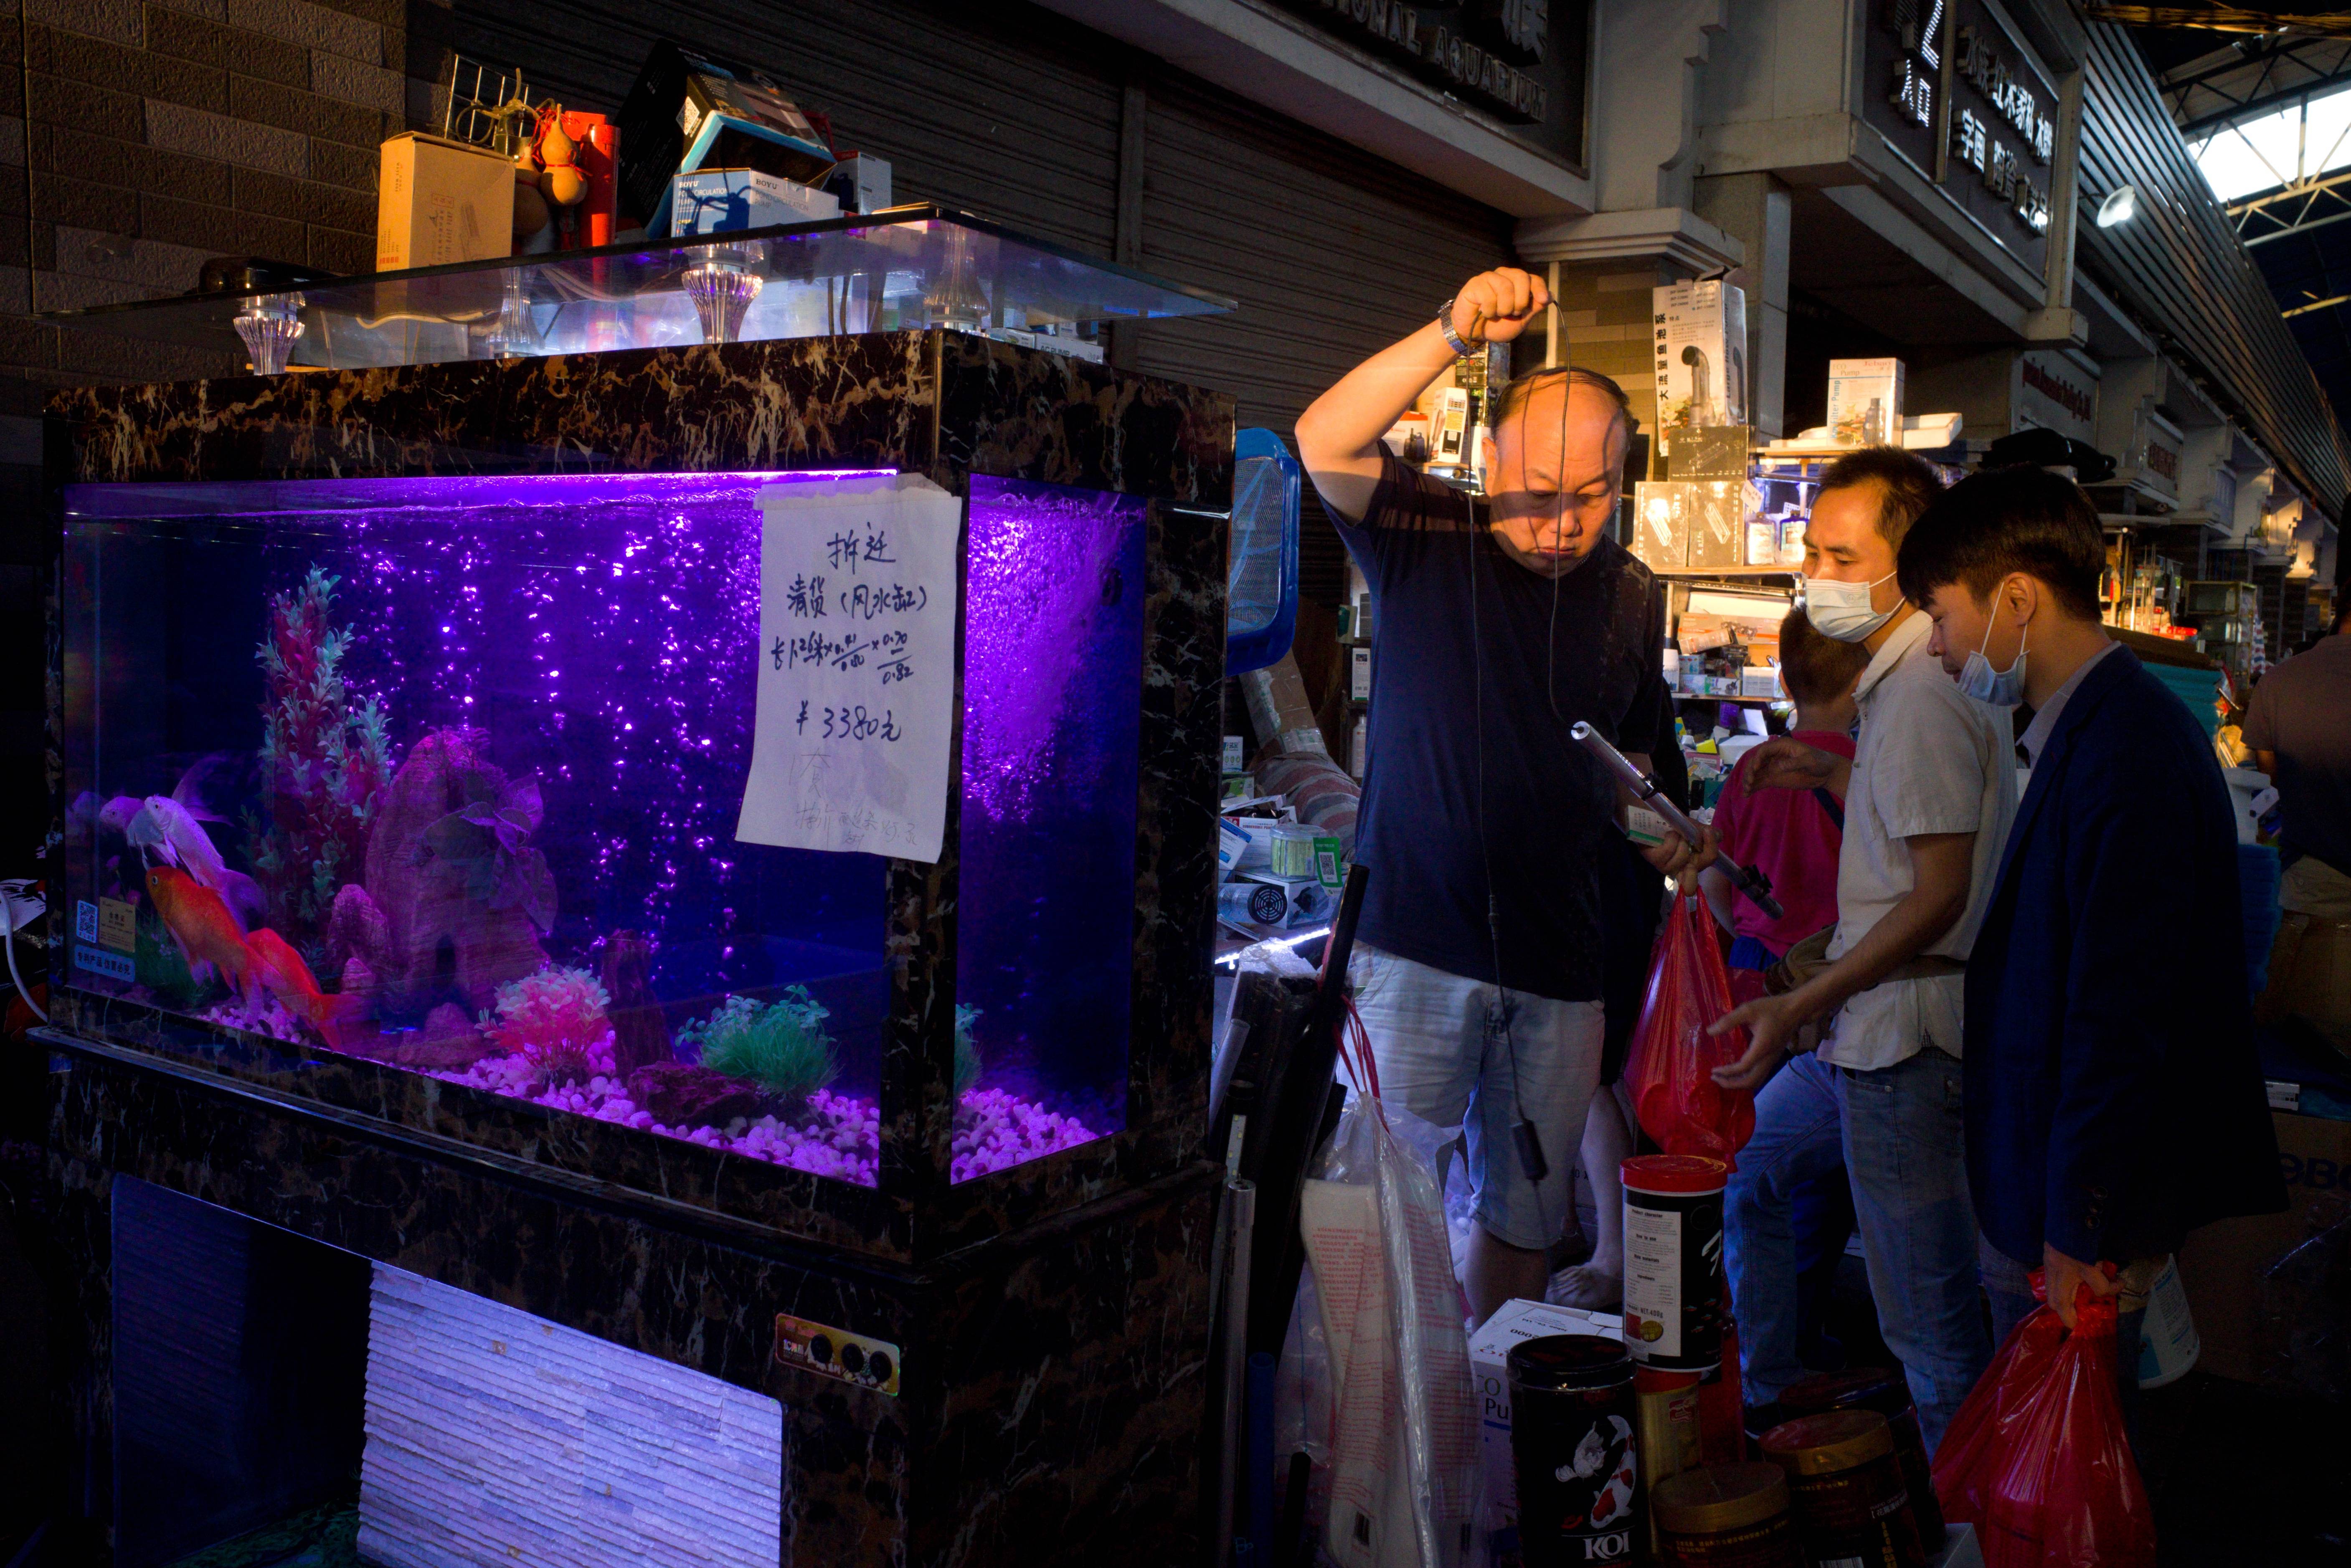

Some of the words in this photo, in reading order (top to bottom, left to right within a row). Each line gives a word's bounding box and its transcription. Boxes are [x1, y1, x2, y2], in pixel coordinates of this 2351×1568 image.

[1433, 25, 1546, 124] AQUARIUM
[1902, 59, 1930, 127] 入口
[756, 179, 777, 189] BOYU
[755, 198, 771, 208] PUMP
[756, 190, 772, 200] POND
[774, 197, 809, 211] CIRCULATION
[1655, 313, 1669, 401] 大流量鱼池泵
[1831, 380, 1841, 401] Pump
[1583, 1532, 1631, 1560] KOI
